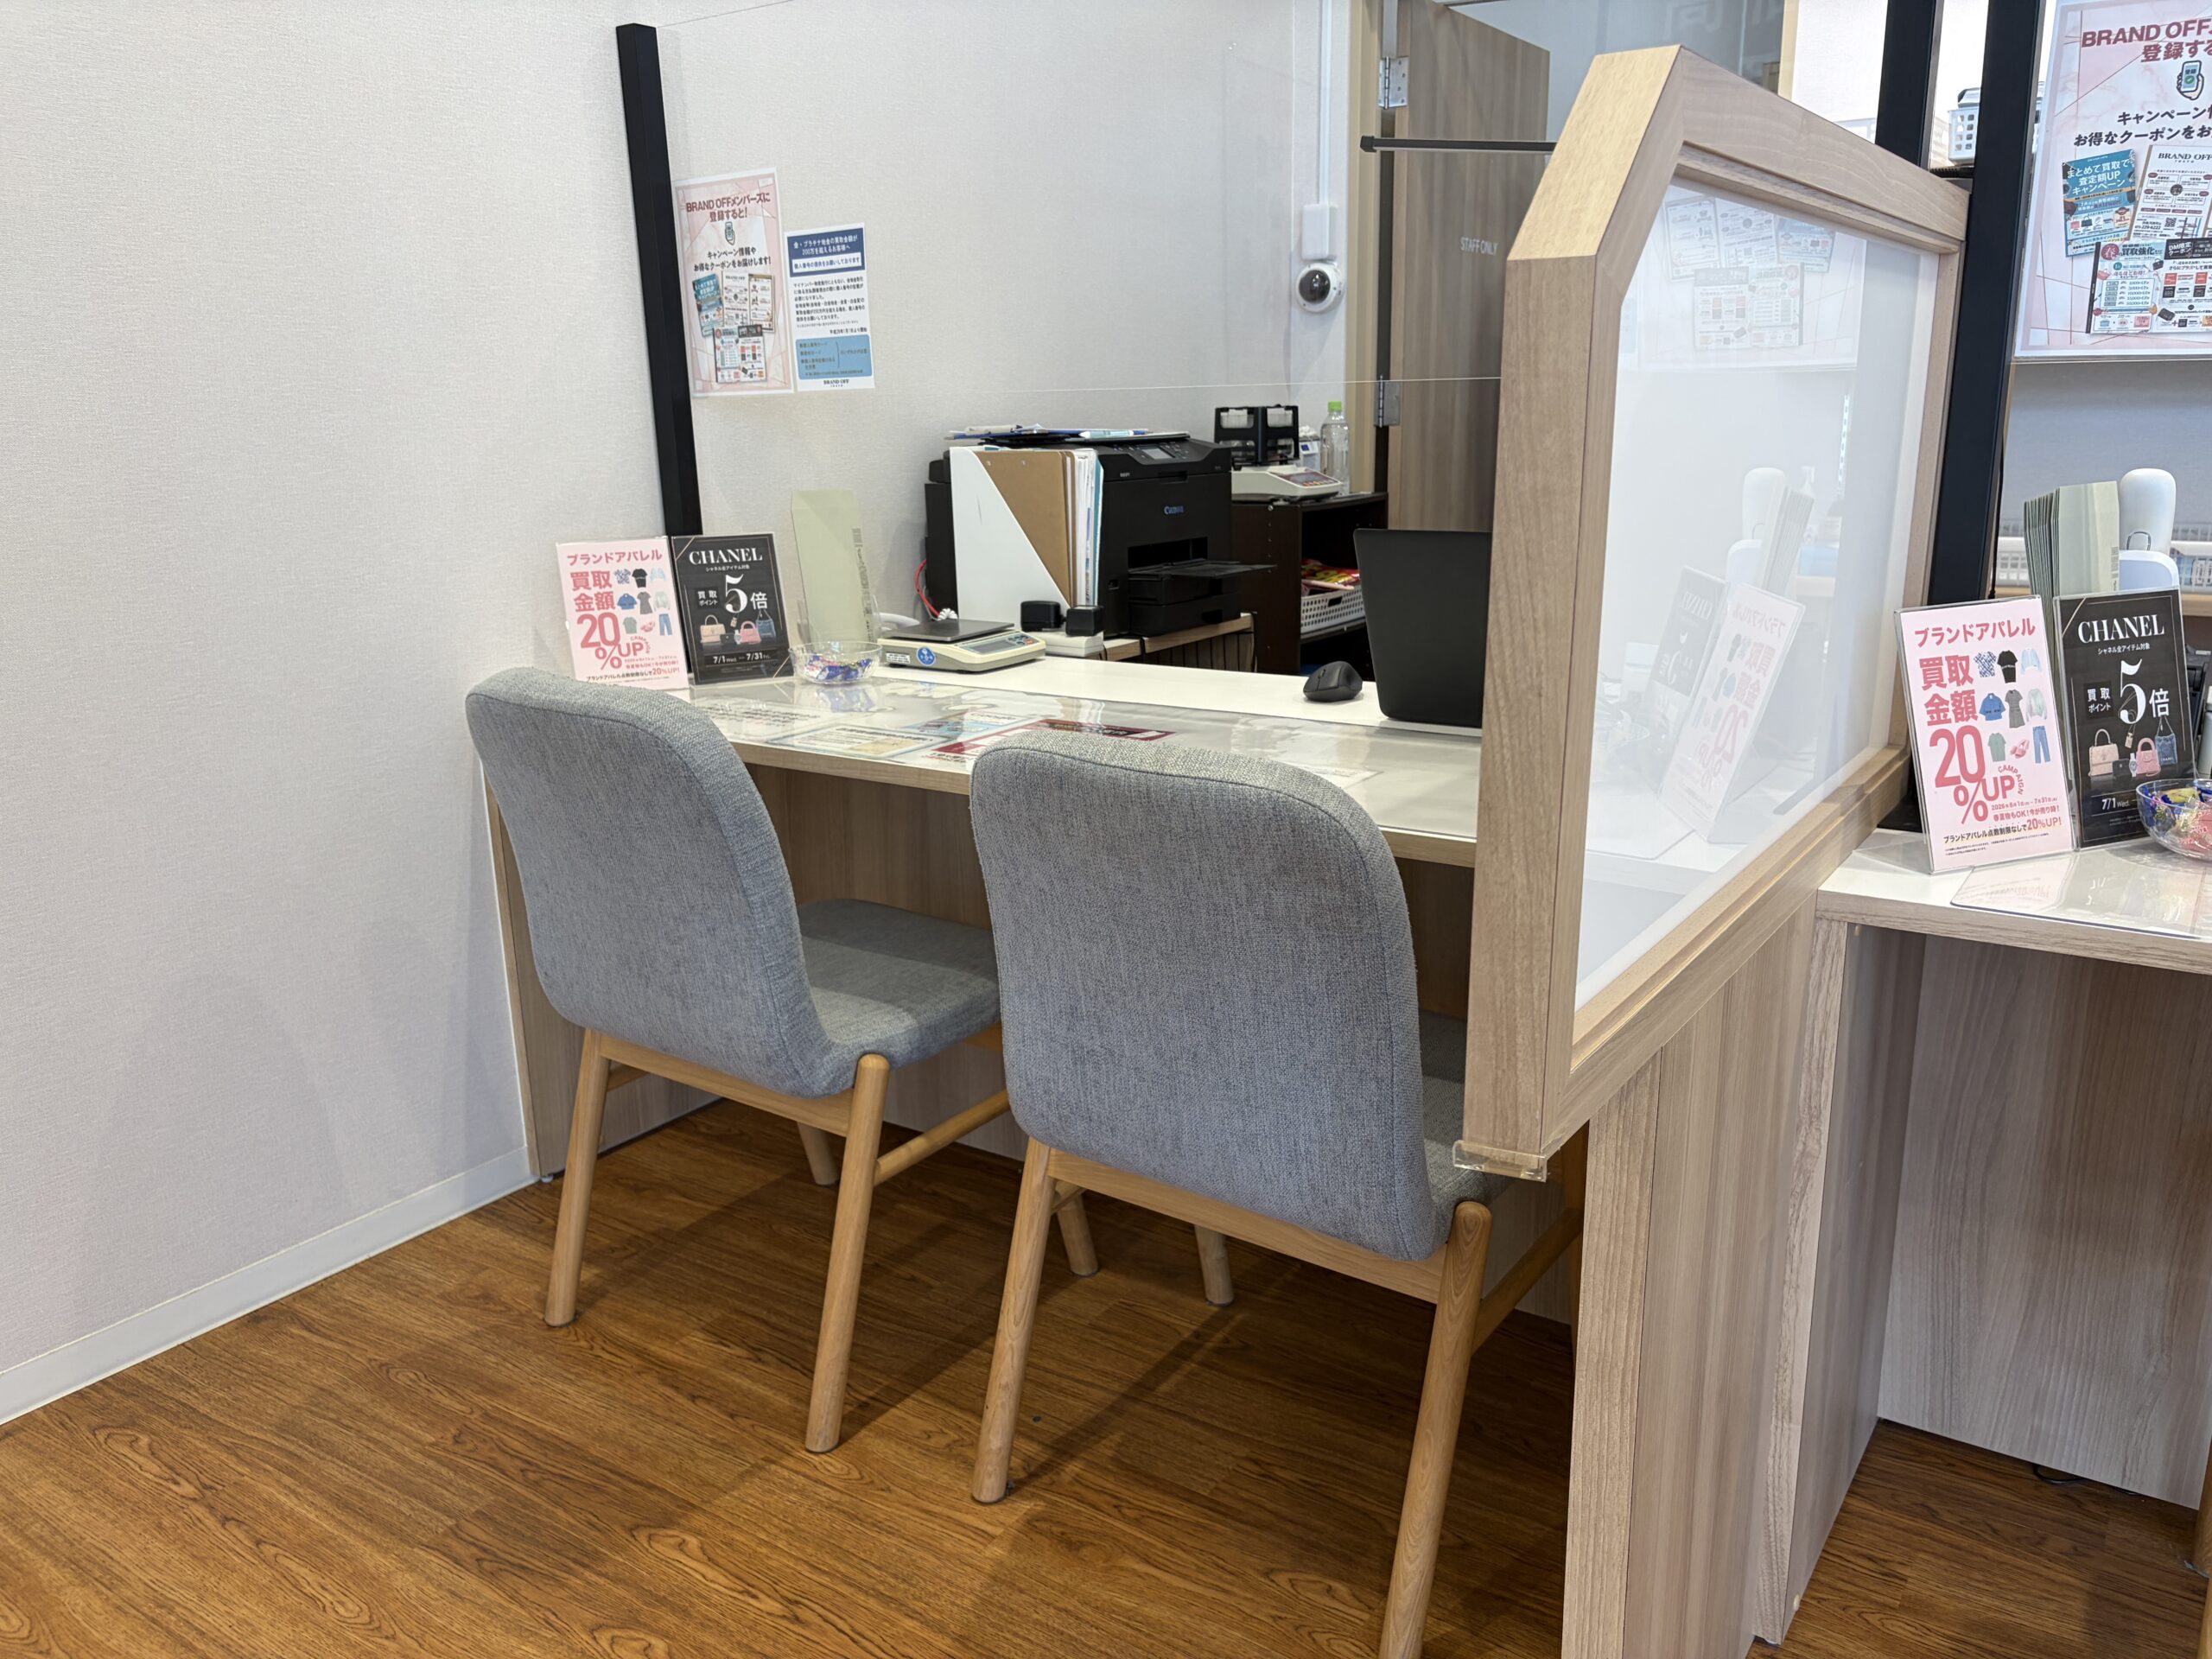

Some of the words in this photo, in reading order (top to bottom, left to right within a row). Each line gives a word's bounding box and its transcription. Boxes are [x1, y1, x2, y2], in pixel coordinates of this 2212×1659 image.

[2081, 24, 2161, 48] BRAND
[2164, 18, 2212, 39] OFF
[2074, 124, 2212, 147] お得なクーポンをお
[2067, 159, 2128, 179] まとめて買取で
[2078, 170, 2120, 187] 査定額UP
[2073, 179, 2126, 195] キャンペーン
[686, 200, 715, 213] BRAND
[715, 193, 771, 207] OFFメンバーズに
[1460, 237, 1479, 252] STAFF
[1481, 240, 1498, 256] ONLY
[689, 547, 763, 565] CHANEL
[570, 570, 613, 591] 買取
[574, 591, 615, 613] 金額
[697, 590, 717, 600] 買取
[724, 573, 748, 613] 5
[750, 592, 768, 610] 倍
[1915, 618, 2036, 648] ブランドアパレル
[2078, 614, 2164, 643] CHANEL
[2097, 643, 2151, 655] シャネル全アイテム対象
[1919, 655, 1974, 690] 買取
[2087, 687, 2110, 702] 買取
[2120, 658, 2146, 725] 5
[2149, 689, 2170, 718] 倍
[1924, 689, 1979, 726] 金額
[2088, 702, 2112, 713] ポイント
[1998, 765, 2024, 795] CAMPAIGN
[2101, 798, 2116, 810] 7/1
